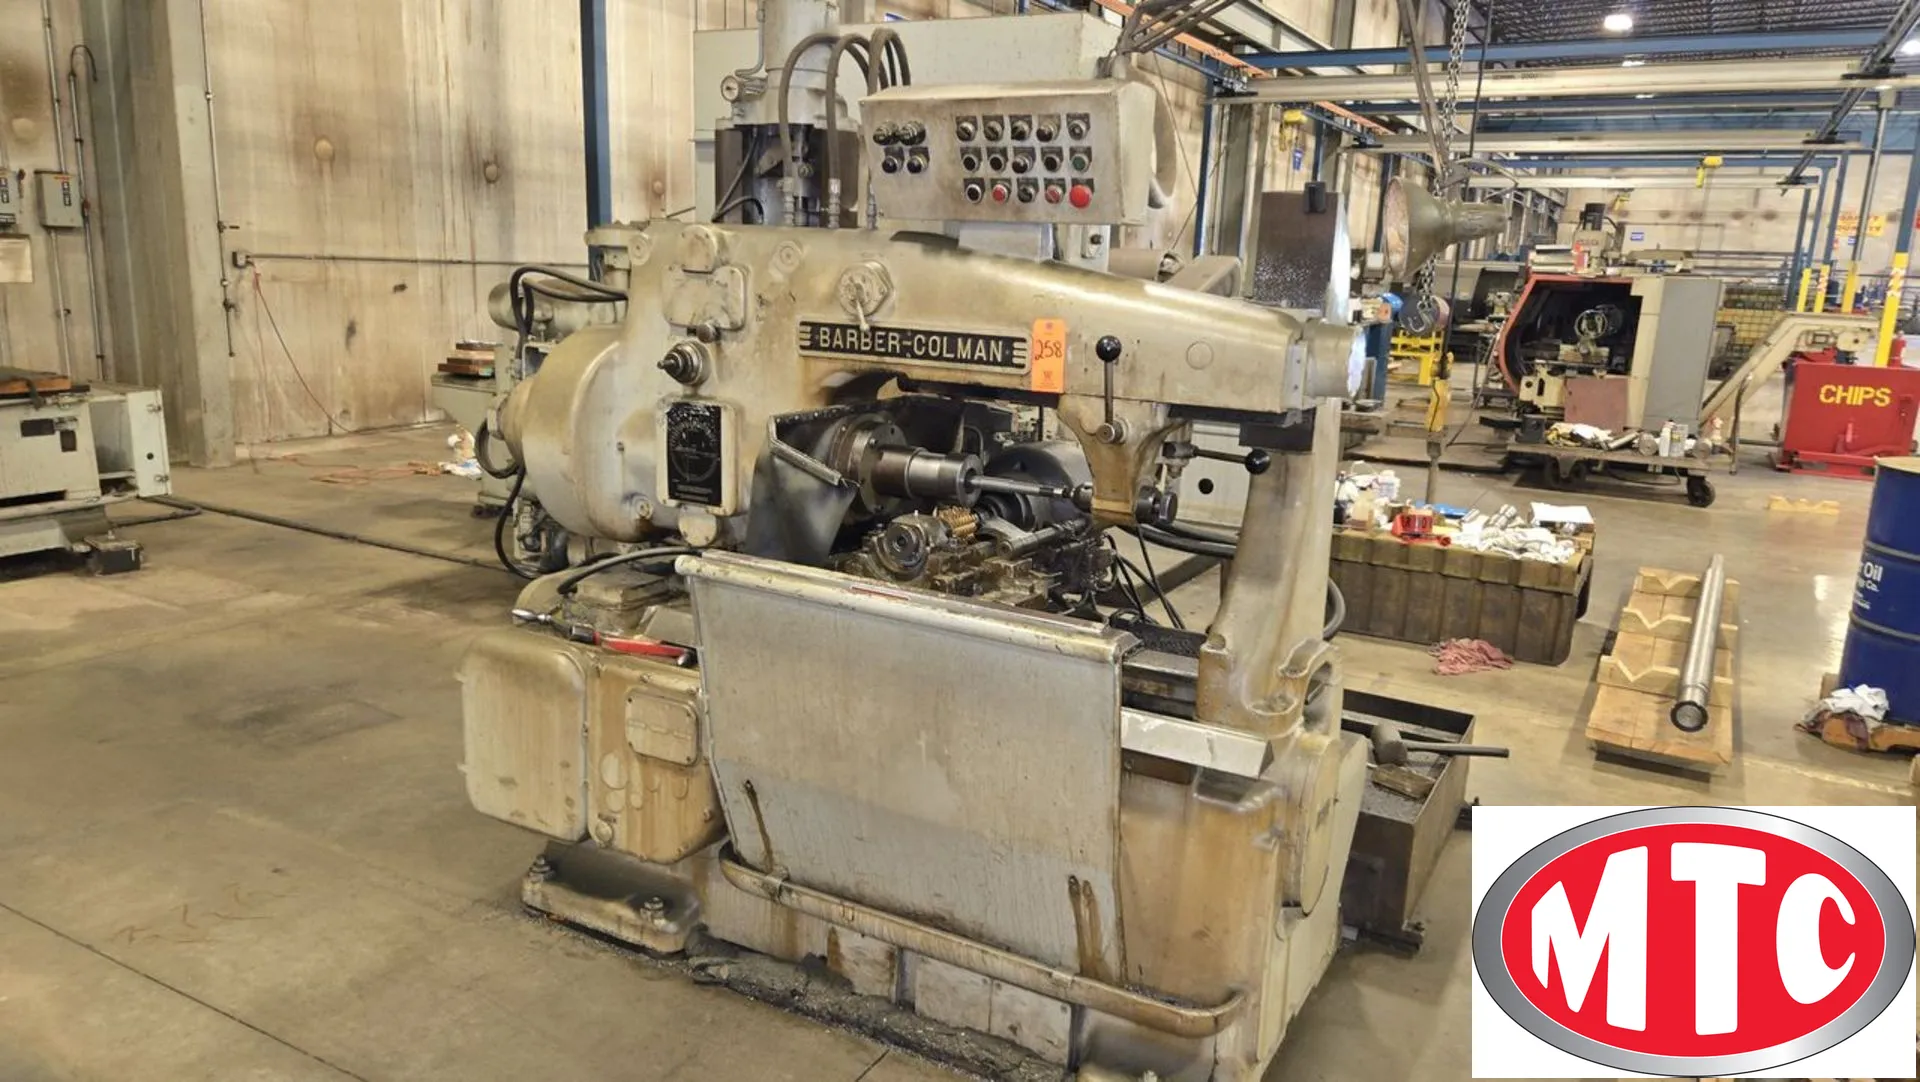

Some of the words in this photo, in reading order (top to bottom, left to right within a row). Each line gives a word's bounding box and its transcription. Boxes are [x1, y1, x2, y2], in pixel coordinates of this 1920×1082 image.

[819, 327, 1003, 363] BARBER-COLMAN
[1034, 339, 1063, 361] 258
[1819, 384, 1892, 407] CHIPS
[1864, 561, 1883, 581] Oil
